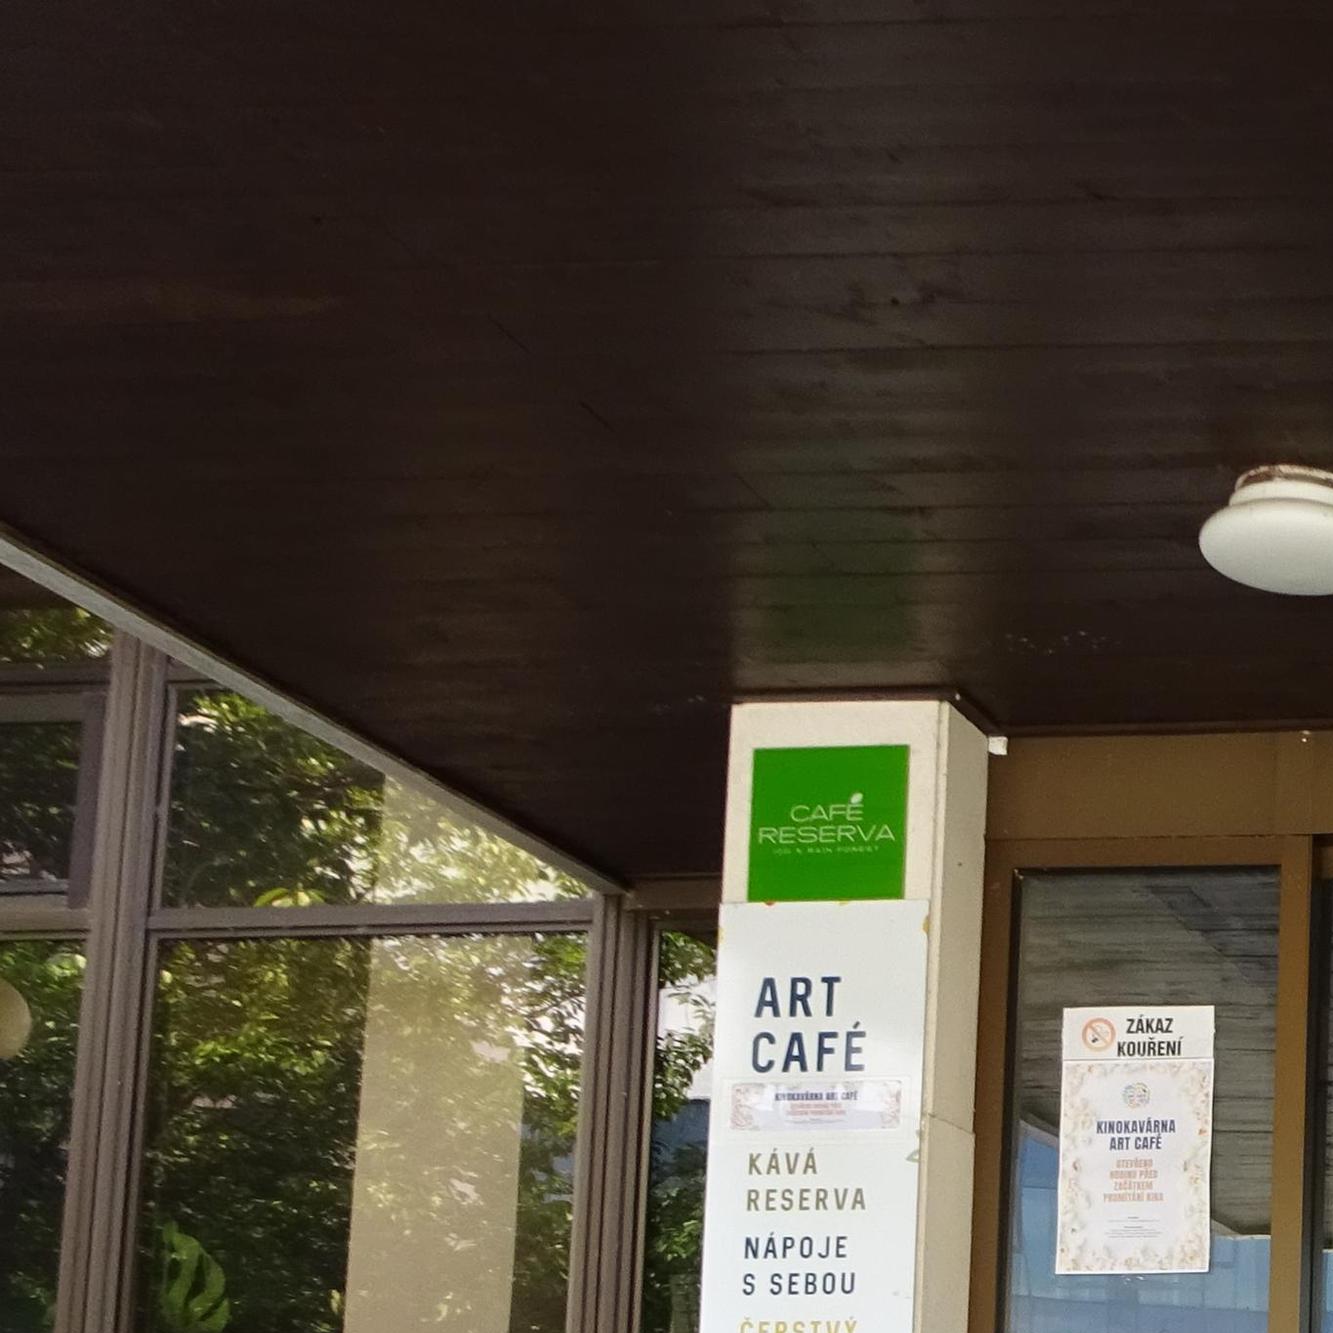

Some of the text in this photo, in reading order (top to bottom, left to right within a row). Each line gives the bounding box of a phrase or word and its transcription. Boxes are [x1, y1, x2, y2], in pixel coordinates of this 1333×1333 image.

[790, 793, 864, 823] CAFÉ
[758, 824, 895, 845] RESERVA
[754, 976, 842, 1018] ART
[1126, 1014, 1174, 1034] ZÁKAZ
[751, 1021, 867, 1073] CAFÉ
[1117, 1036, 1184, 1057] KOUŘENÍ
[1096, 1116, 1176, 1134] KINOKAVÁRNA
[1109, 1133, 1162, 1151] ART CAFÉ
[748, 1148, 818, 1175] KÁVÁ
[746, 1187, 867, 1212] RESERVA
[743, 1232, 849, 1259] NÁPOJE
[742, 1272, 856, 1296] S SEBOU
